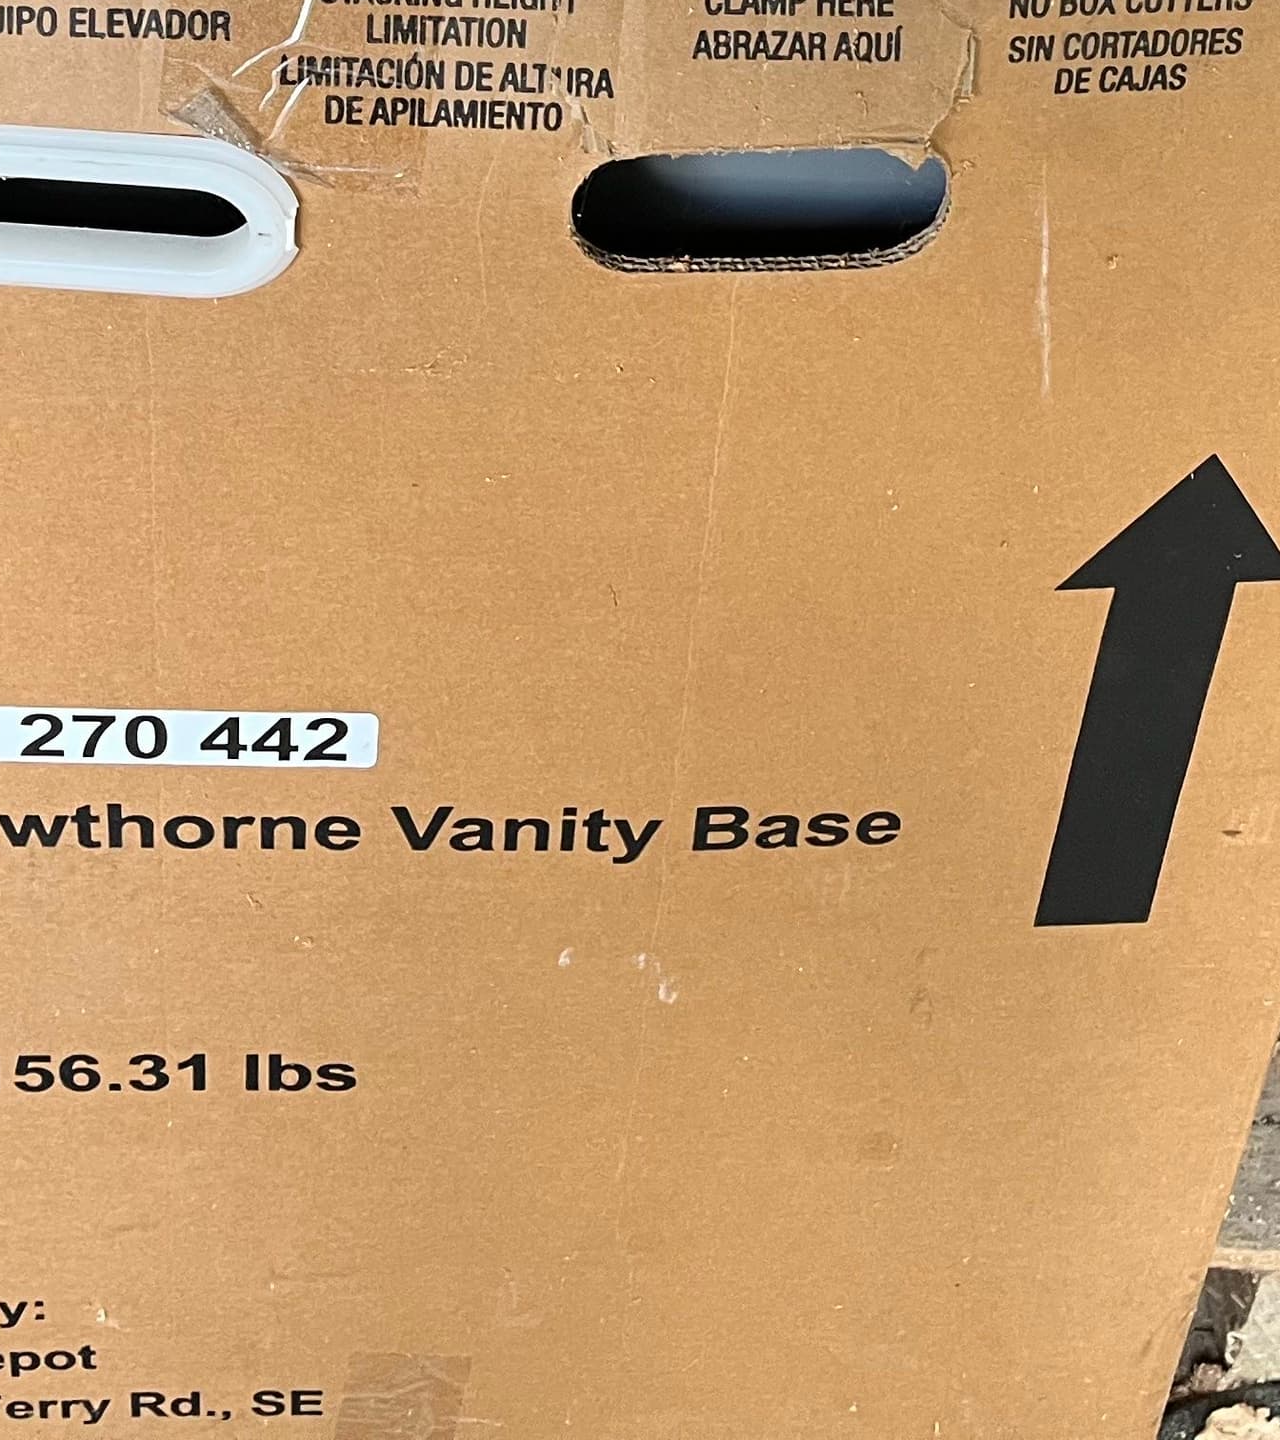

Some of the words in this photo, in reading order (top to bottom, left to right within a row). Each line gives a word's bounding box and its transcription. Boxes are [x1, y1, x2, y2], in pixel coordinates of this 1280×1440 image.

[69, 7, 231, 42] ELEVADOR
[366, 12, 527, 49] LIMITATION
[691, 29, 827, 62] ABRAZAR
[832, 24, 904, 64] AQUÍ
[1007, 34, 1056, 64] SIN
[1063, 27, 1244, 61] CORTADORES
[279, 52, 445, 90] LIMITACIÓN
[454, 60, 494, 92] DE
[1053, 66, 1093, 95] DE
[1098, 62, 1188, 94] CAJAS
[324, 94, 364, 126] DE
[368, 96, 563, 132] APILAMIENTO
[20, 713, 168, 760] 270
[200, 716, 348, 762] 442
[390, 806, 664, 865] Vanity
[691, 806, 901, 852] Base
[245, 1053, 357, 1092] lbs
[130, 1391, 232, 1421] Rd.,
[251, 1390, 324, 1417] SE
